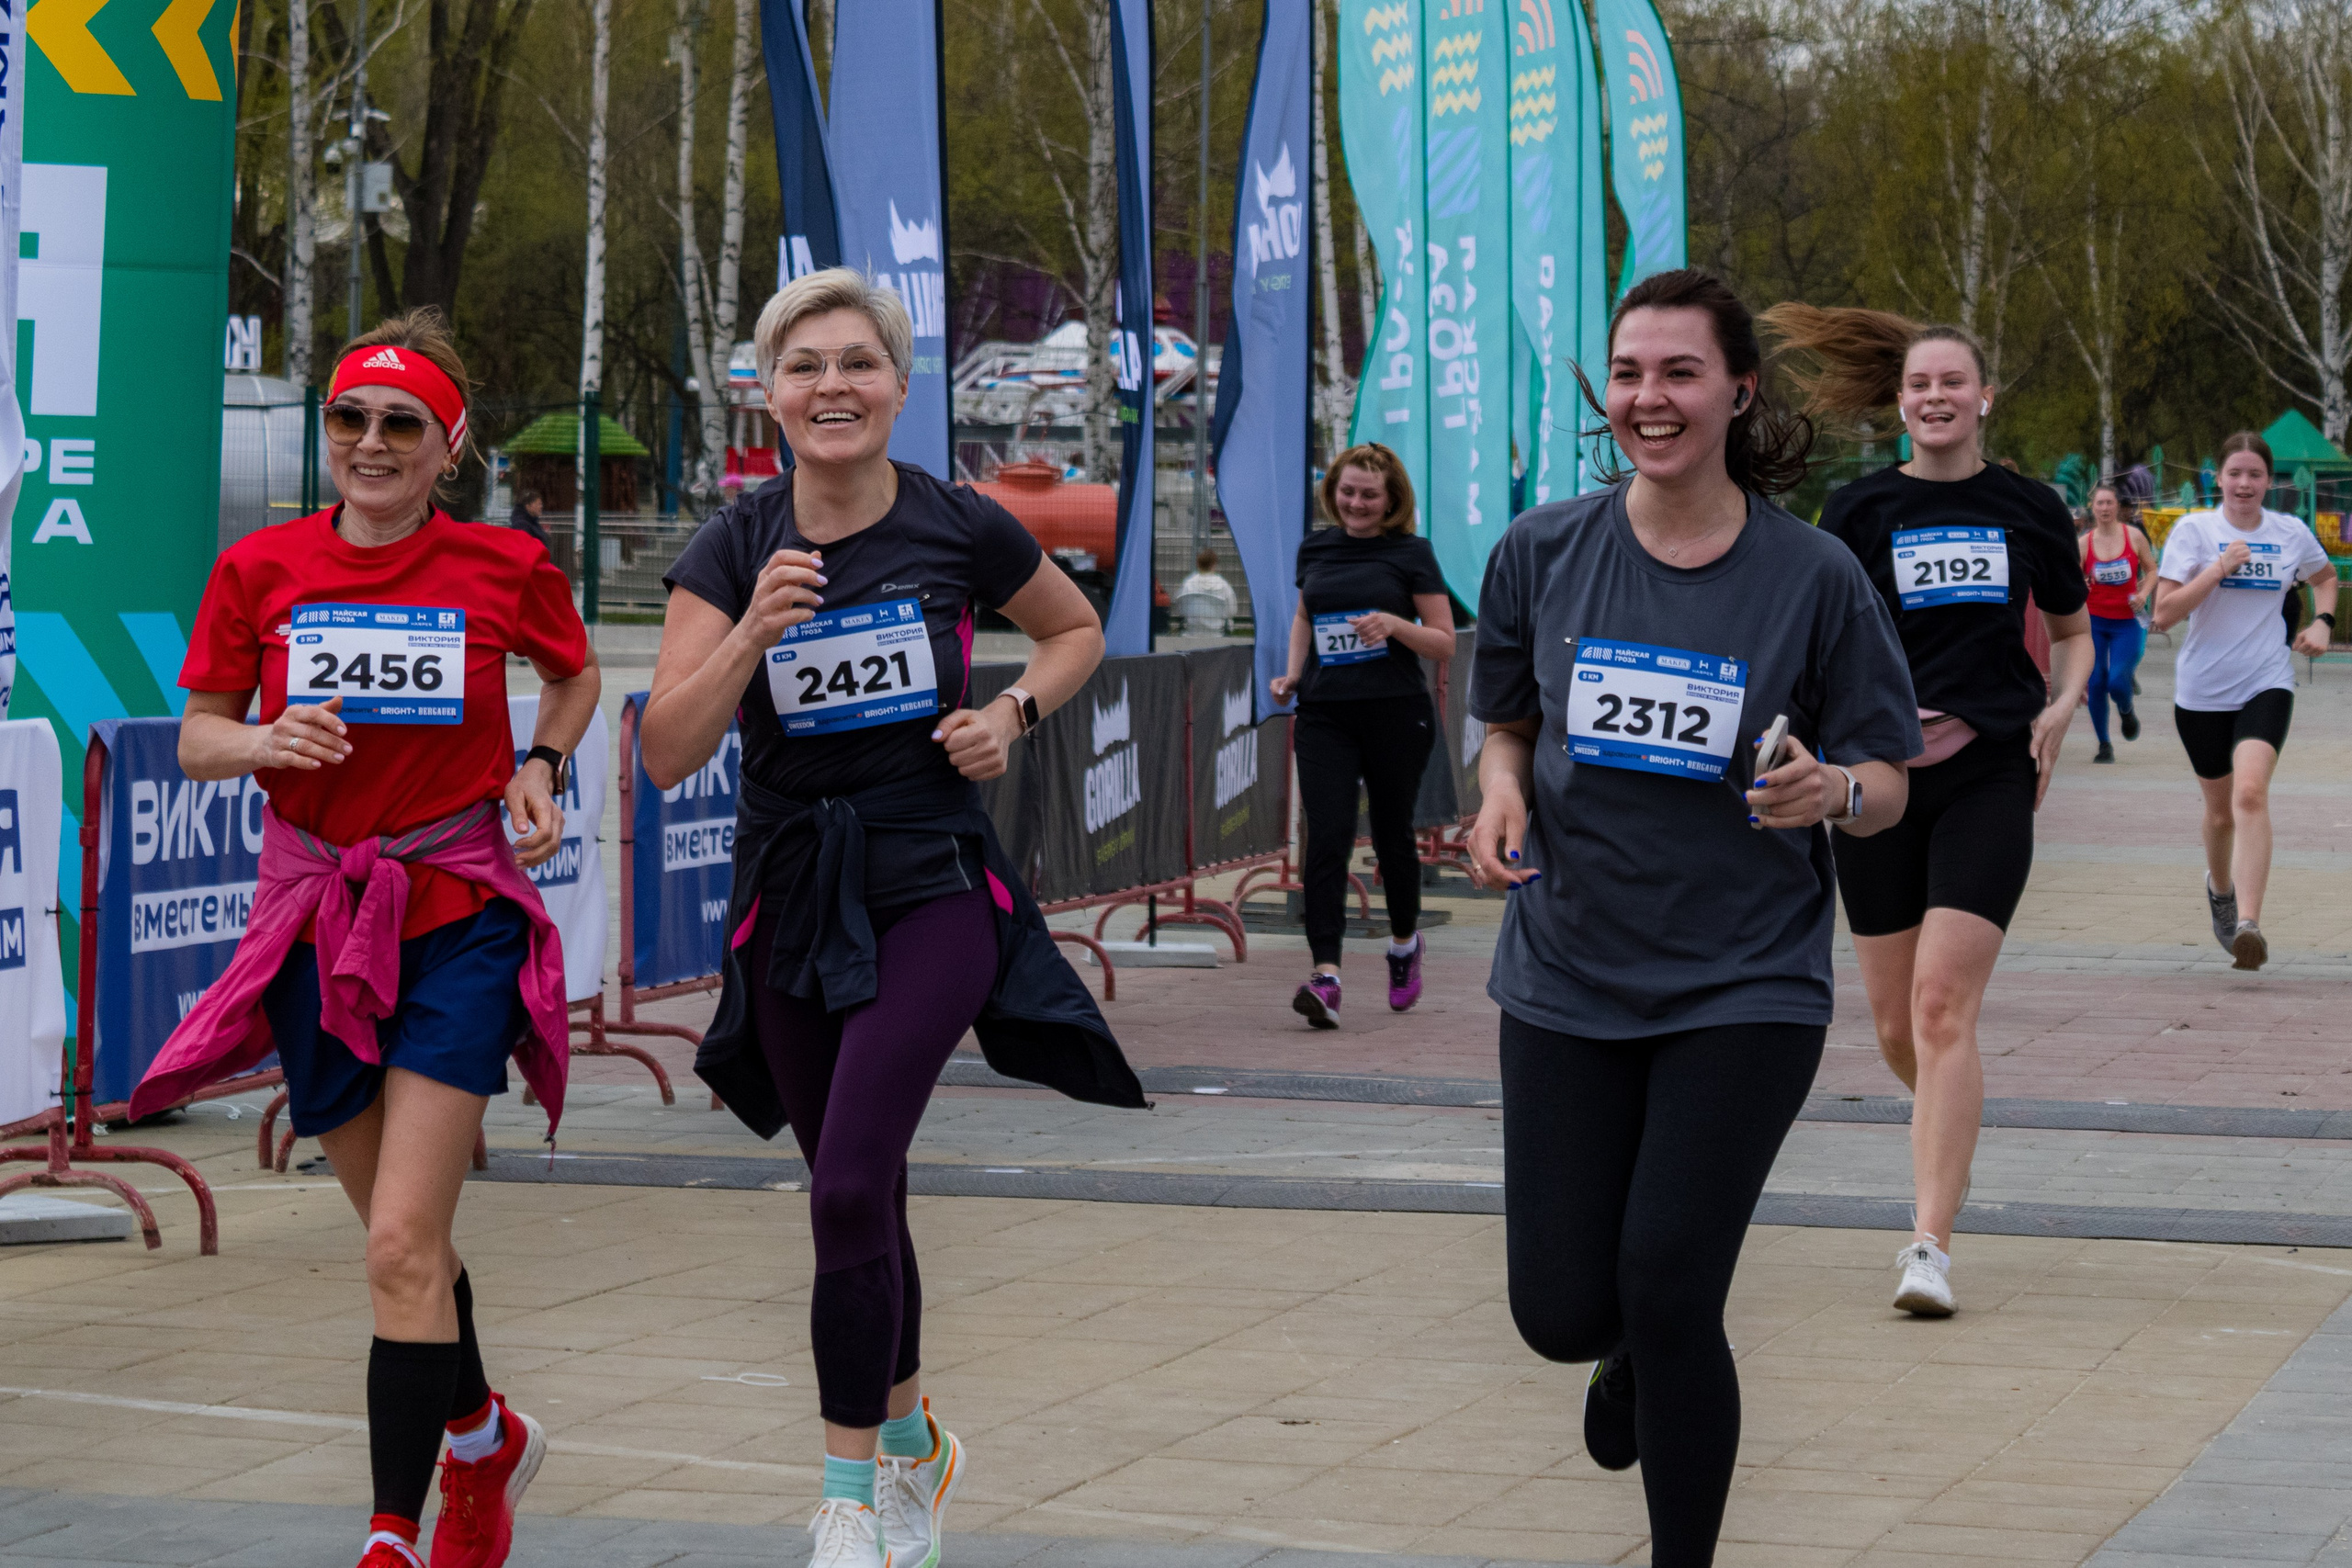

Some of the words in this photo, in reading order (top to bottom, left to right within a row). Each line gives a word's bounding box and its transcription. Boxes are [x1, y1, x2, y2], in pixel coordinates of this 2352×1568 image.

[362, 360, 406, 371] adidas
[1914, 558, 1992, 587] 2192
[2100, 570, 2127, 581] 2539
[332, 610, 368, 618] МАЙСКАЯ
[800, 619, 833, 631] МАЙСКАЯ
[801, 627, 823, 636] ГРОЗА
[876, 627, 923, 641] ВИКТОРИЯ
[408, 635, 460, 643] ВИКТОРИЯ
[1327, 634, 1371, 652] 217
[1614, 656, 1637, 664] ГРОЗА
[1615, 649, 1650, 660] МАЙСКАЯ
[309, 652, 443, 692] 2456
[795, 650, 911, 705] 2421
[1687, 682, 1740, 699] ВИКТОРИЯ
[380, 707, 412, 716] BRIGHT
[418, 707, 456, 716] BERGAUER
[900, 699, 933, 712] BERGAUER
[1592, 694, 1711, 747] 2312
[1649, 755, 1680, 766] BRIGHT
[1687, 761, 1723, 774] BERGAUER
[1084, 741, 1142, 834] GORILLA
[130, 773, 270, 865] ВИКТО
